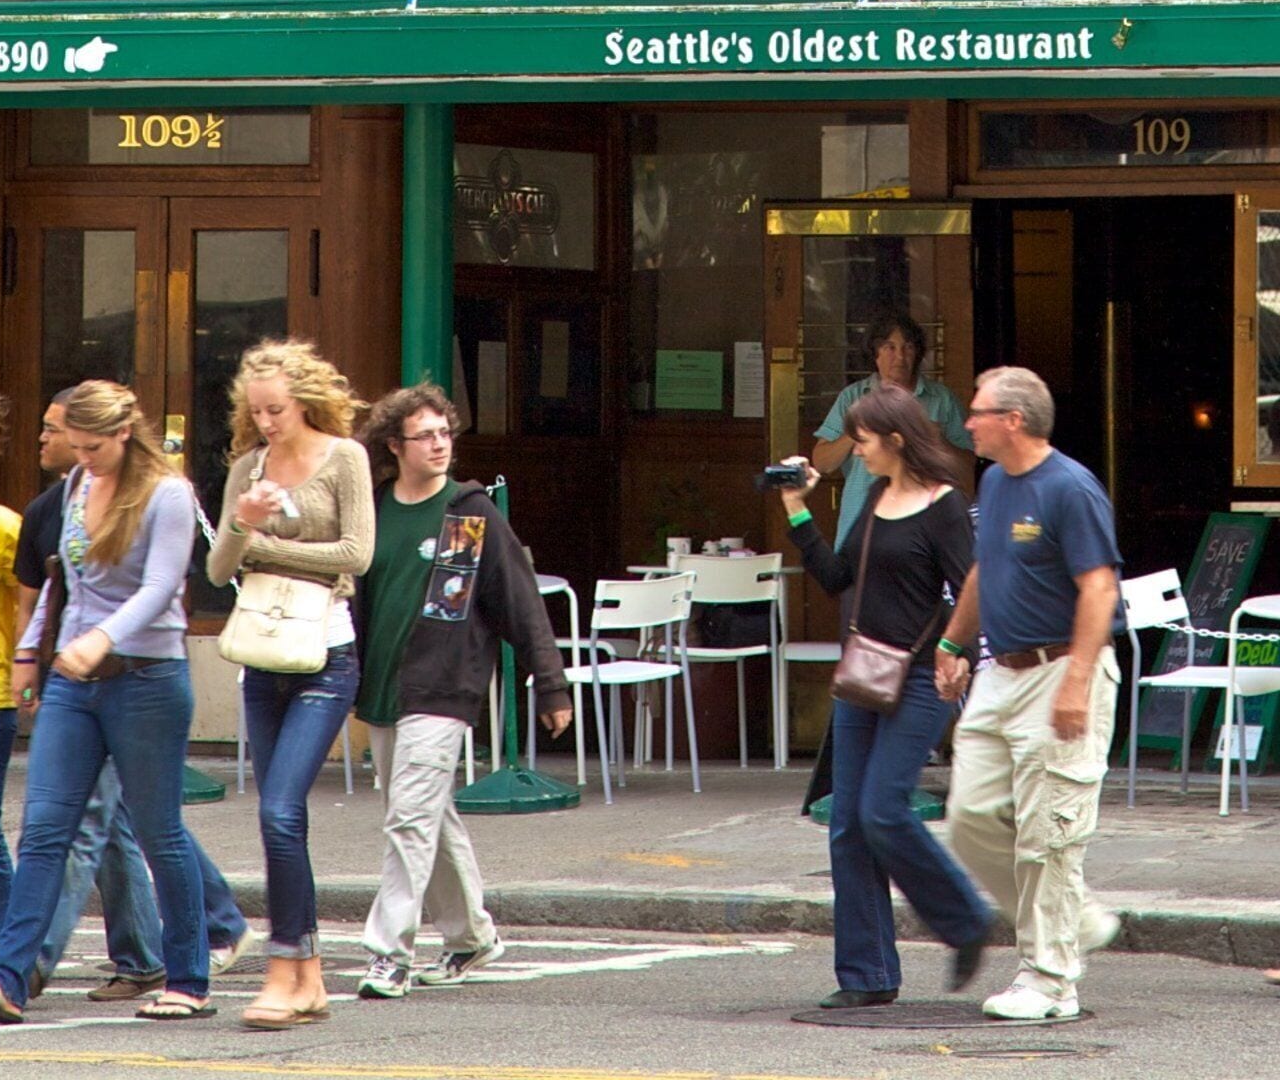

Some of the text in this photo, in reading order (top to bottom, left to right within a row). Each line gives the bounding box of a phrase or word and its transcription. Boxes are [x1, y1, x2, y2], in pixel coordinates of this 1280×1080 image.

[604, 27, 1094, 65] Seattle's Oldest Restaurant
[1133, 118, 1190, 157] 109
